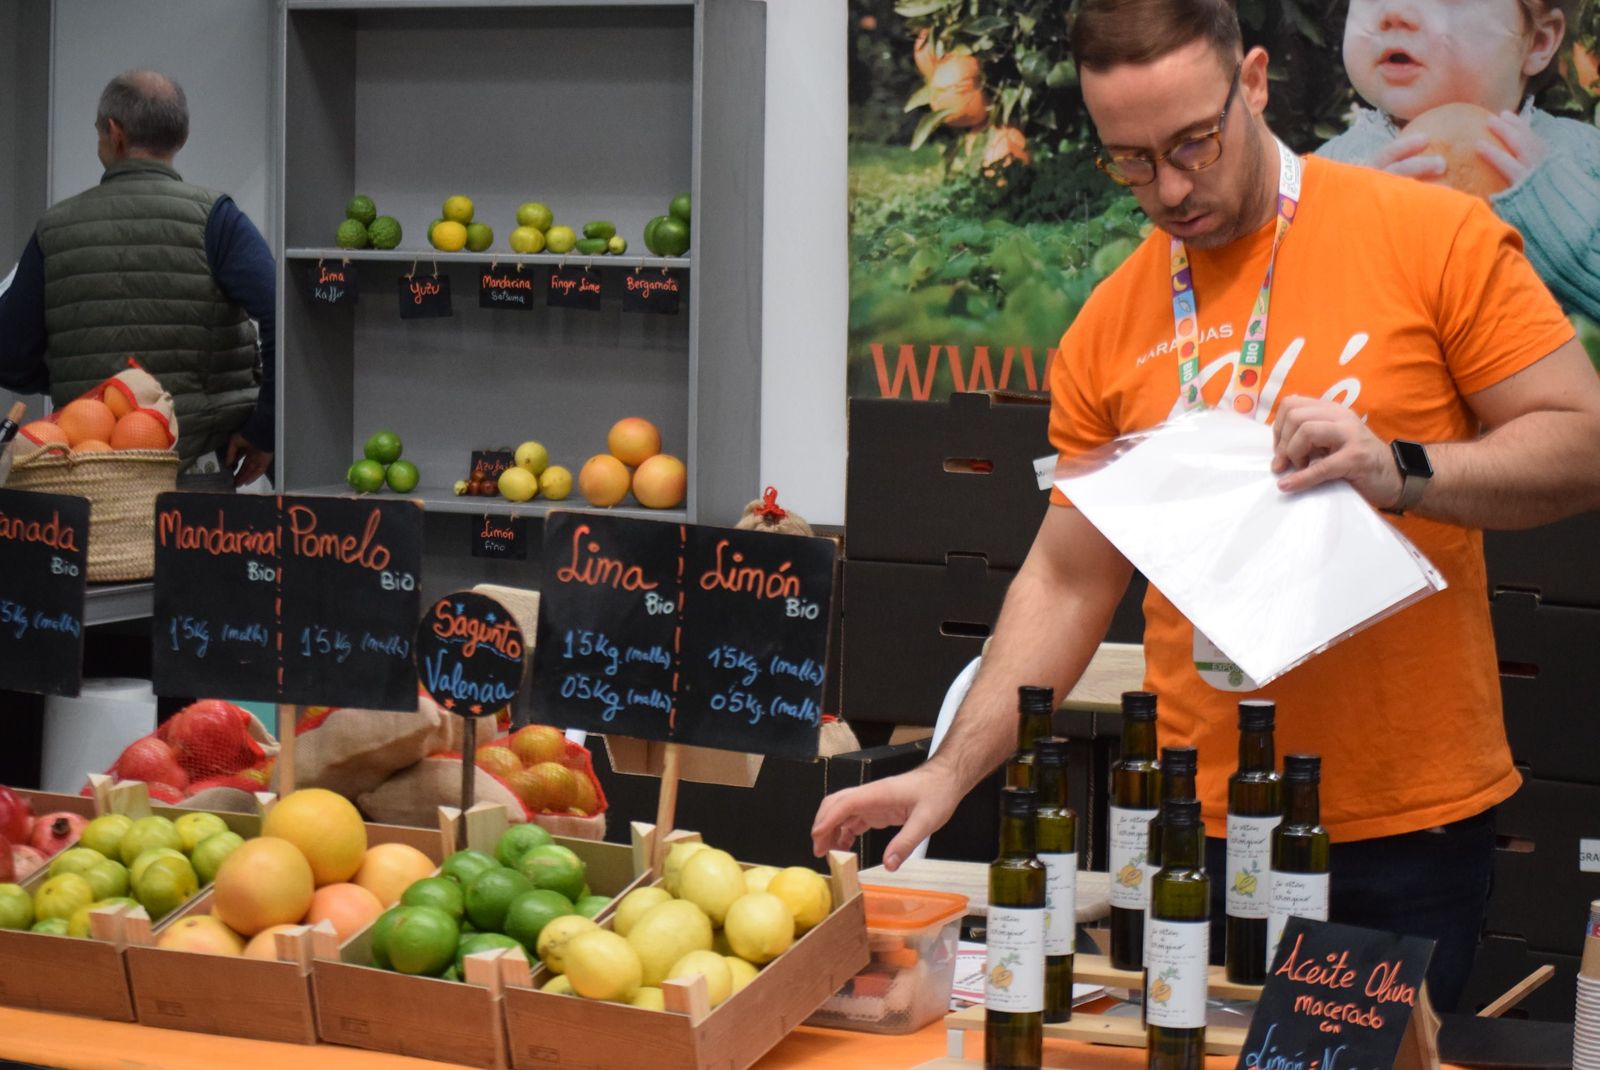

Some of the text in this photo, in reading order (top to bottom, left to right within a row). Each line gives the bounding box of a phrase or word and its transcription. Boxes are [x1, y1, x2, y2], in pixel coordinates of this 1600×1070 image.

[319, 267, 345, 284] Lima
[482, 275, 532, 290] Mandarina
[579, 278, 600, 293] Lime
[626, 276, 679, 298] Bergamota
[410, 282, 440, 304] Yuzu
[491, 290, 525, 304] Satsuma
[1136, 323, 1234, 367] NARAJAS
[1245, 342, 1260, 364] BIO
[1182, 364, 1193, 382] BIO
[0, 511, 80, 552] anada
[159, 509, 276, 556] Mandarina
[288, 505, 391, 572] Pomelo
[480, 520, 515, 541] Limón
[51, 557, 79, 577] Bio
[557, 524, 659, 591] Lima
[699, 539, 800, 600] Limón
[247, 561, 276, 582] Bio
[381, 571, 415, 592] Bio
[645, 592, 674, 616] Bio
[785, 598, 820, 620] Bio
[432, 599, 521, 658] Sagunto
[625, 646, 672, 670] (malla)
[425, 648, 519, 703] Valencia
[770, 656, 825, 688] (malla)
[627, 688, 673, 714] (malla)
[770, 696, 821, 728] (malla)
[1275, 933, 1417, 1007] Aceite Oliva
[1294, 994, 1385, 1030] macerado
[1318, 1020, 1344, 1035] con
